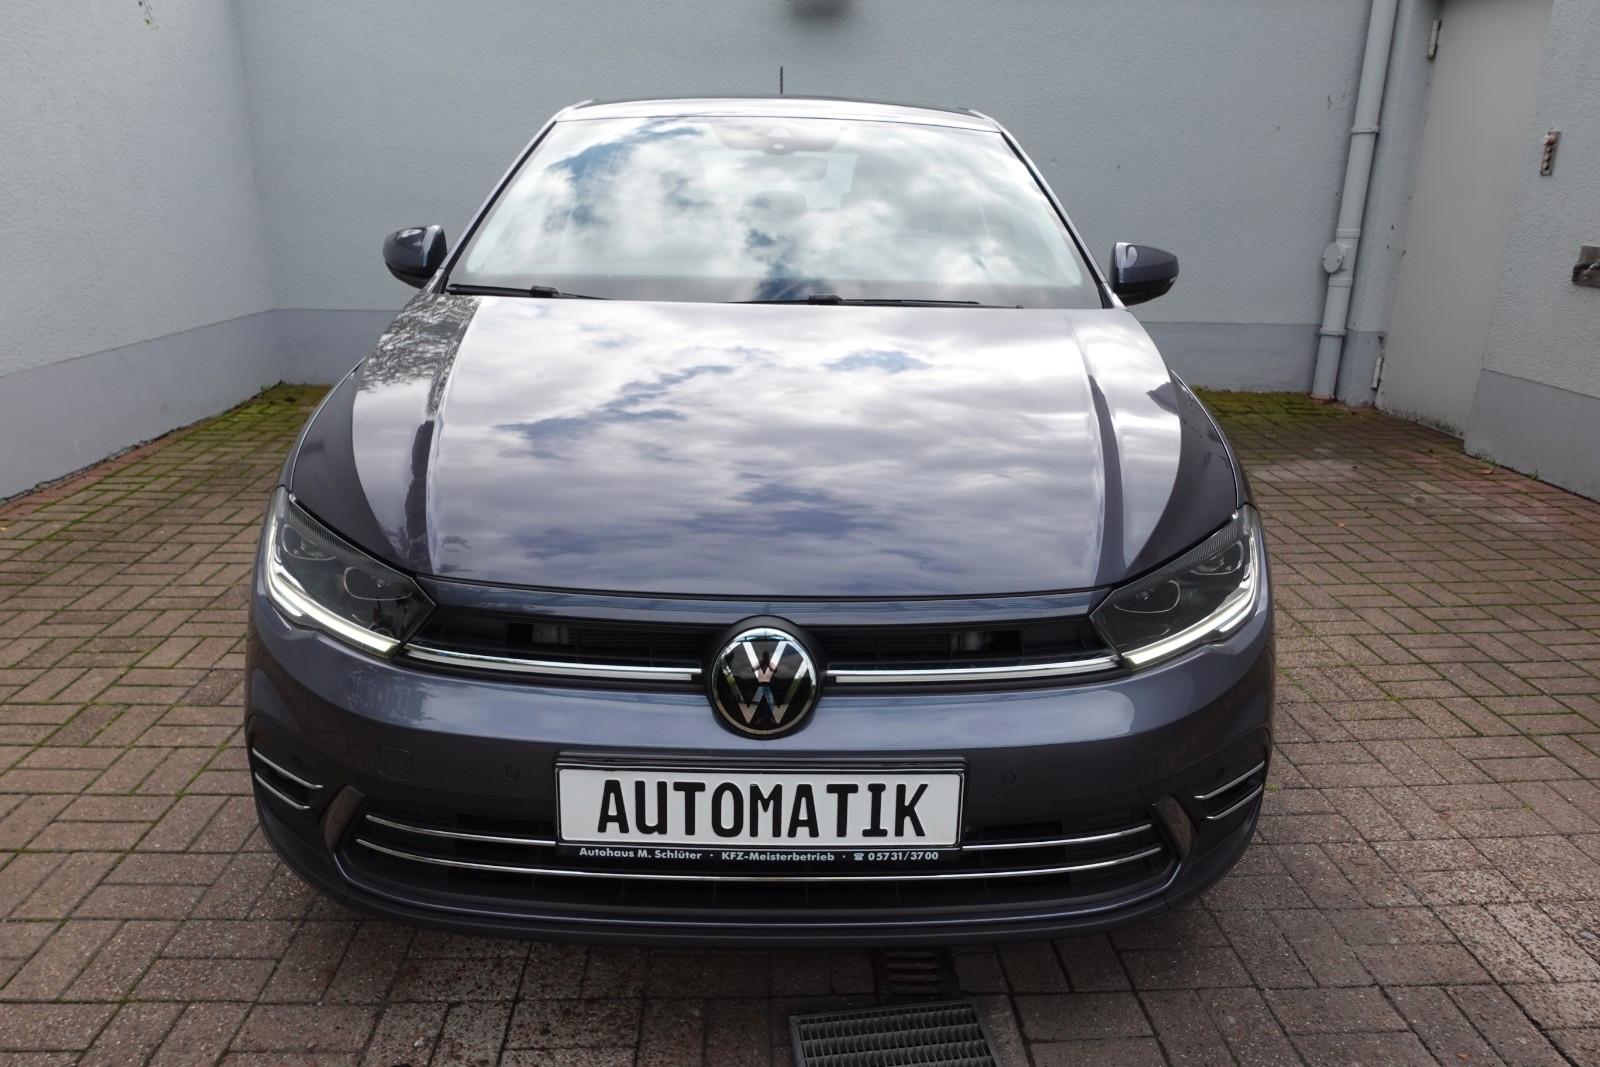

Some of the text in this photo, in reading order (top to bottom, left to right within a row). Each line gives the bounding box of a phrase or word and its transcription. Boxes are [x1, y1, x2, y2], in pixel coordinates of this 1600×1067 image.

[597, 779, 929, 838] AUTOMATIK
[579, 848, 940, 861] Autohaus M. Schlüter KFZ-Meisterbetrieb 05731/3700
